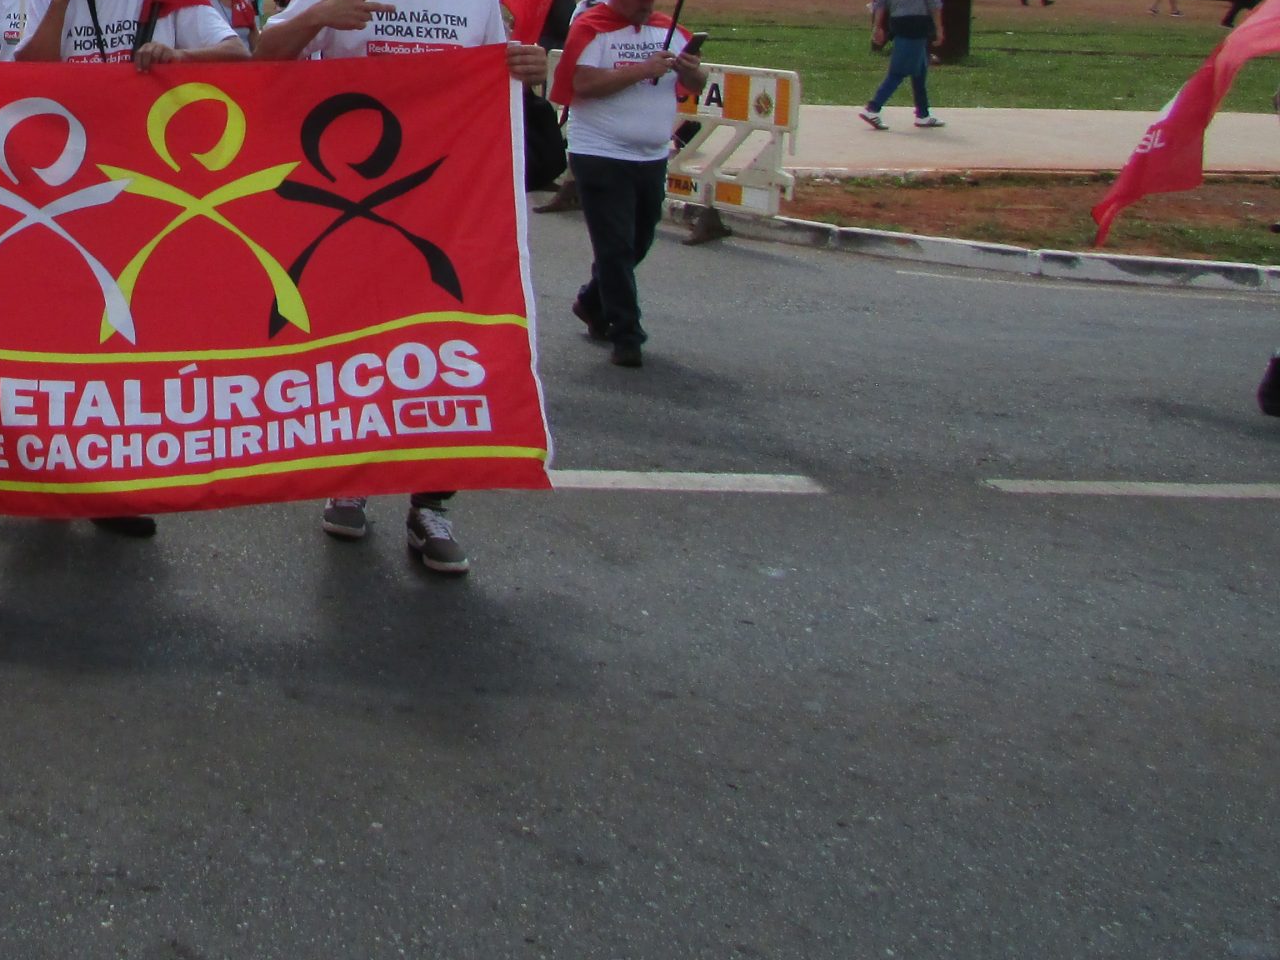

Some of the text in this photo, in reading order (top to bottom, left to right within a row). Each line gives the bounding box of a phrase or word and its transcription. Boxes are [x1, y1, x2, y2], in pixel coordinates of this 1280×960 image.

[375, 9, 468, 27] VIDA NÃO TEM
[105, 19, 132, 35] NÃO
[374, 24, 459, 40] HORA EXTRA
[110, 33, 136, 49] EXTR
[16, 398, 390, 471] CACHOEIRINHA
[395, 397, 491, 433] CUT
